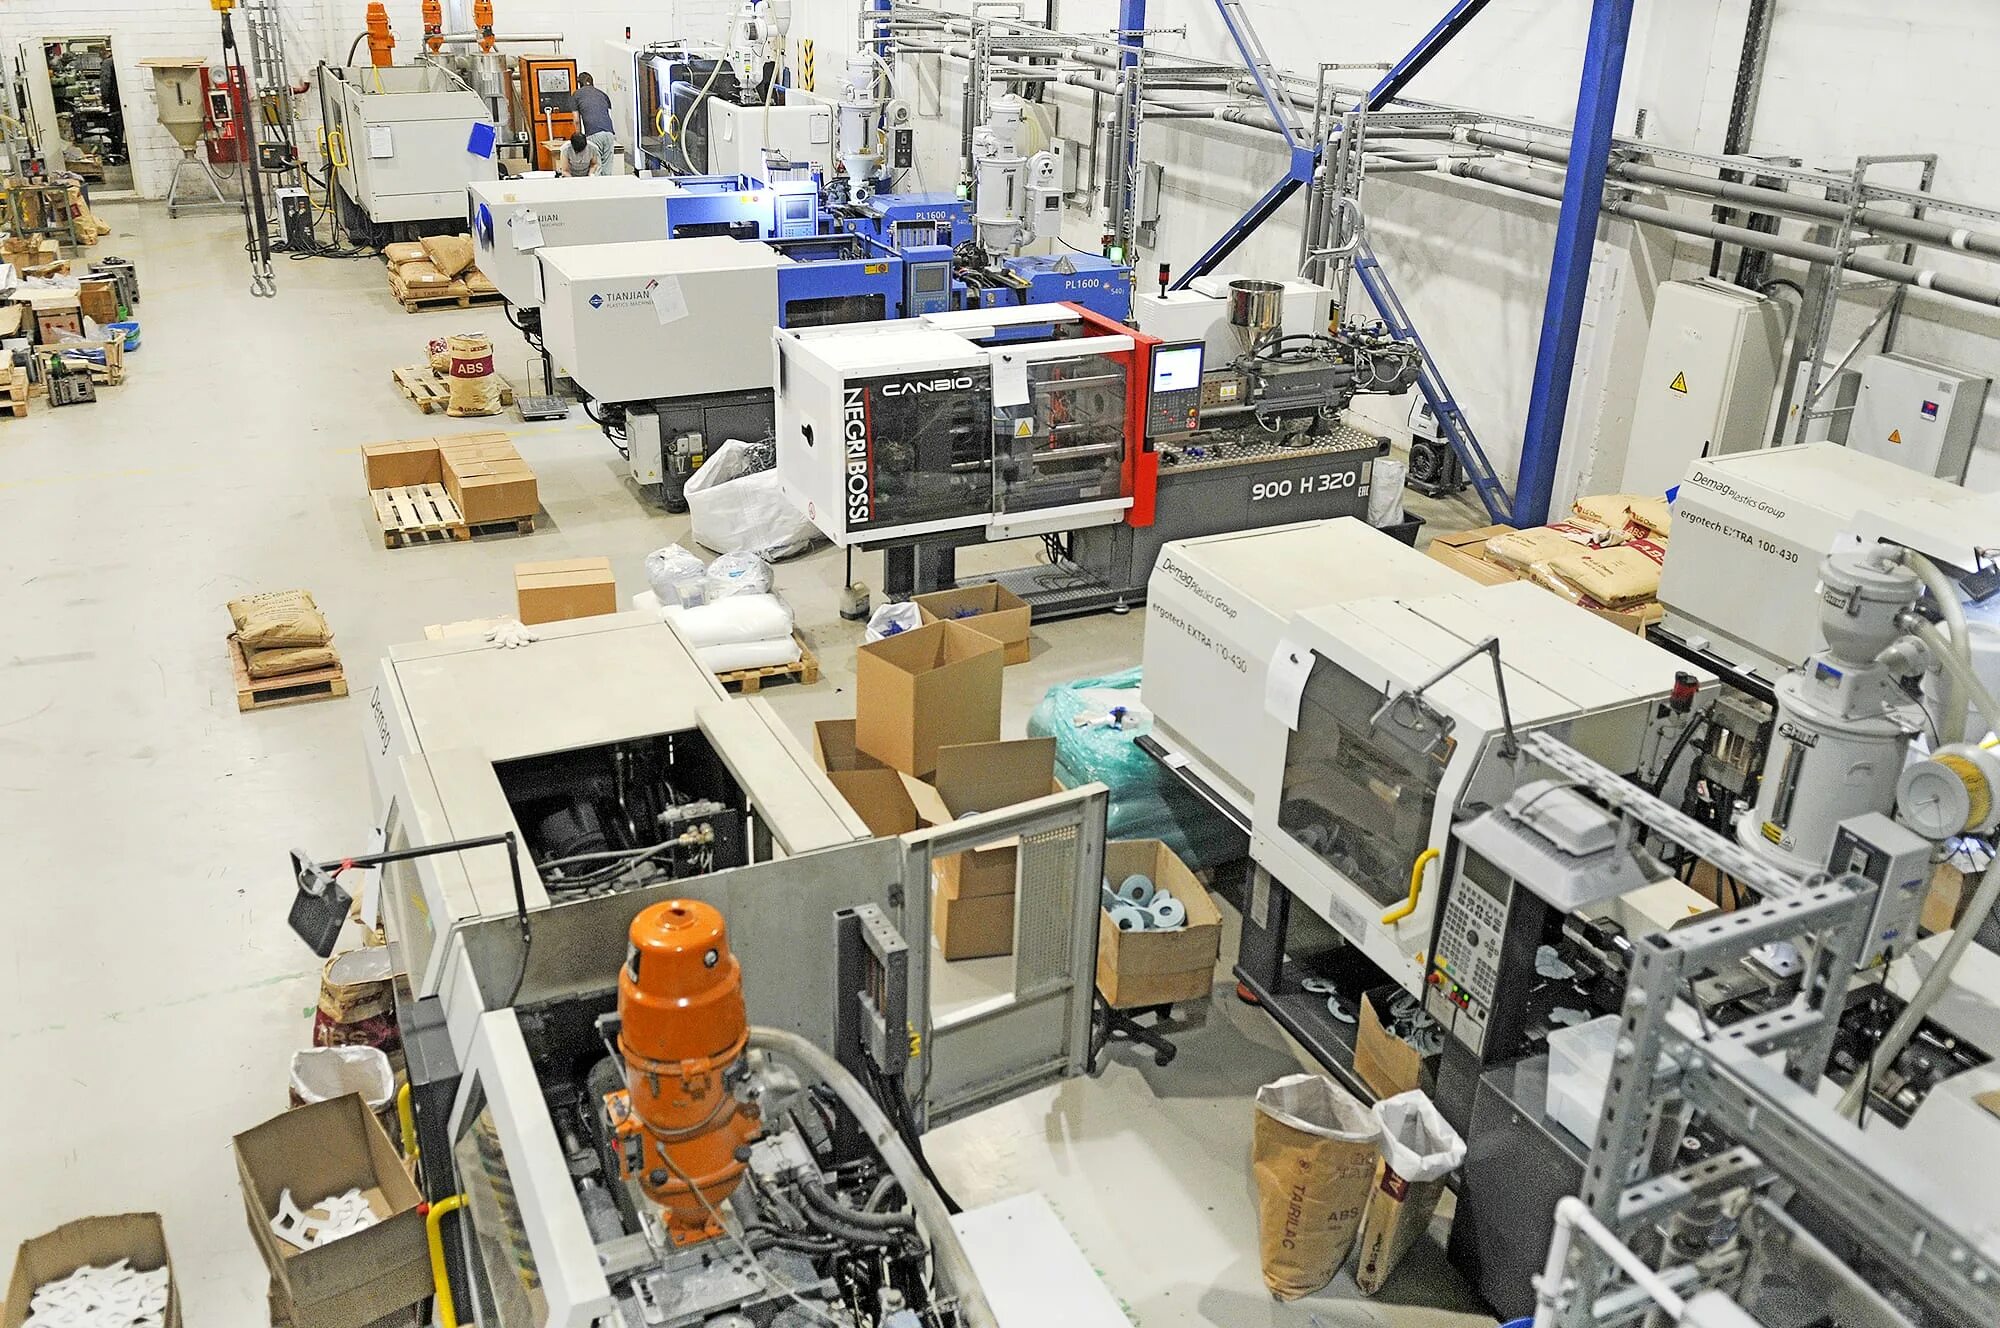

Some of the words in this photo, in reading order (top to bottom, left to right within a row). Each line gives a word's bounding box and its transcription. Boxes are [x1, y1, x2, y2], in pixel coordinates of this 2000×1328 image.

[916, 211, 946, 220] PL1600
[1065, 279, 1099, 289] PL1600
[606, 291, 650, 302] TIANJIAN
[458, 363, 484, 374] ABS
[882, 376, 973, 397] CANBIO
[844, 387, 867, 459] NEGRI
[847, 460, 869, 524] BOSSI
[1252, 480, 1292, 501] 900
[1300, 476, 1313, 494] H
[1317, 471, 1356, 492] 320
[1757, 501, 1786, 519] Group
[1628, 526, 1645, 539] ABS
[1680, 509, 1722, 532] ergotech
[1758, 539, 1799, 563] 100-430
[1153, 602, 1186, 631] ergotech
[1214, 597, 1237, 619] Group
[1282, 1184, 1306, 1251] TAIRILAC
[1327, 1207, 1359, 1223] ABS
